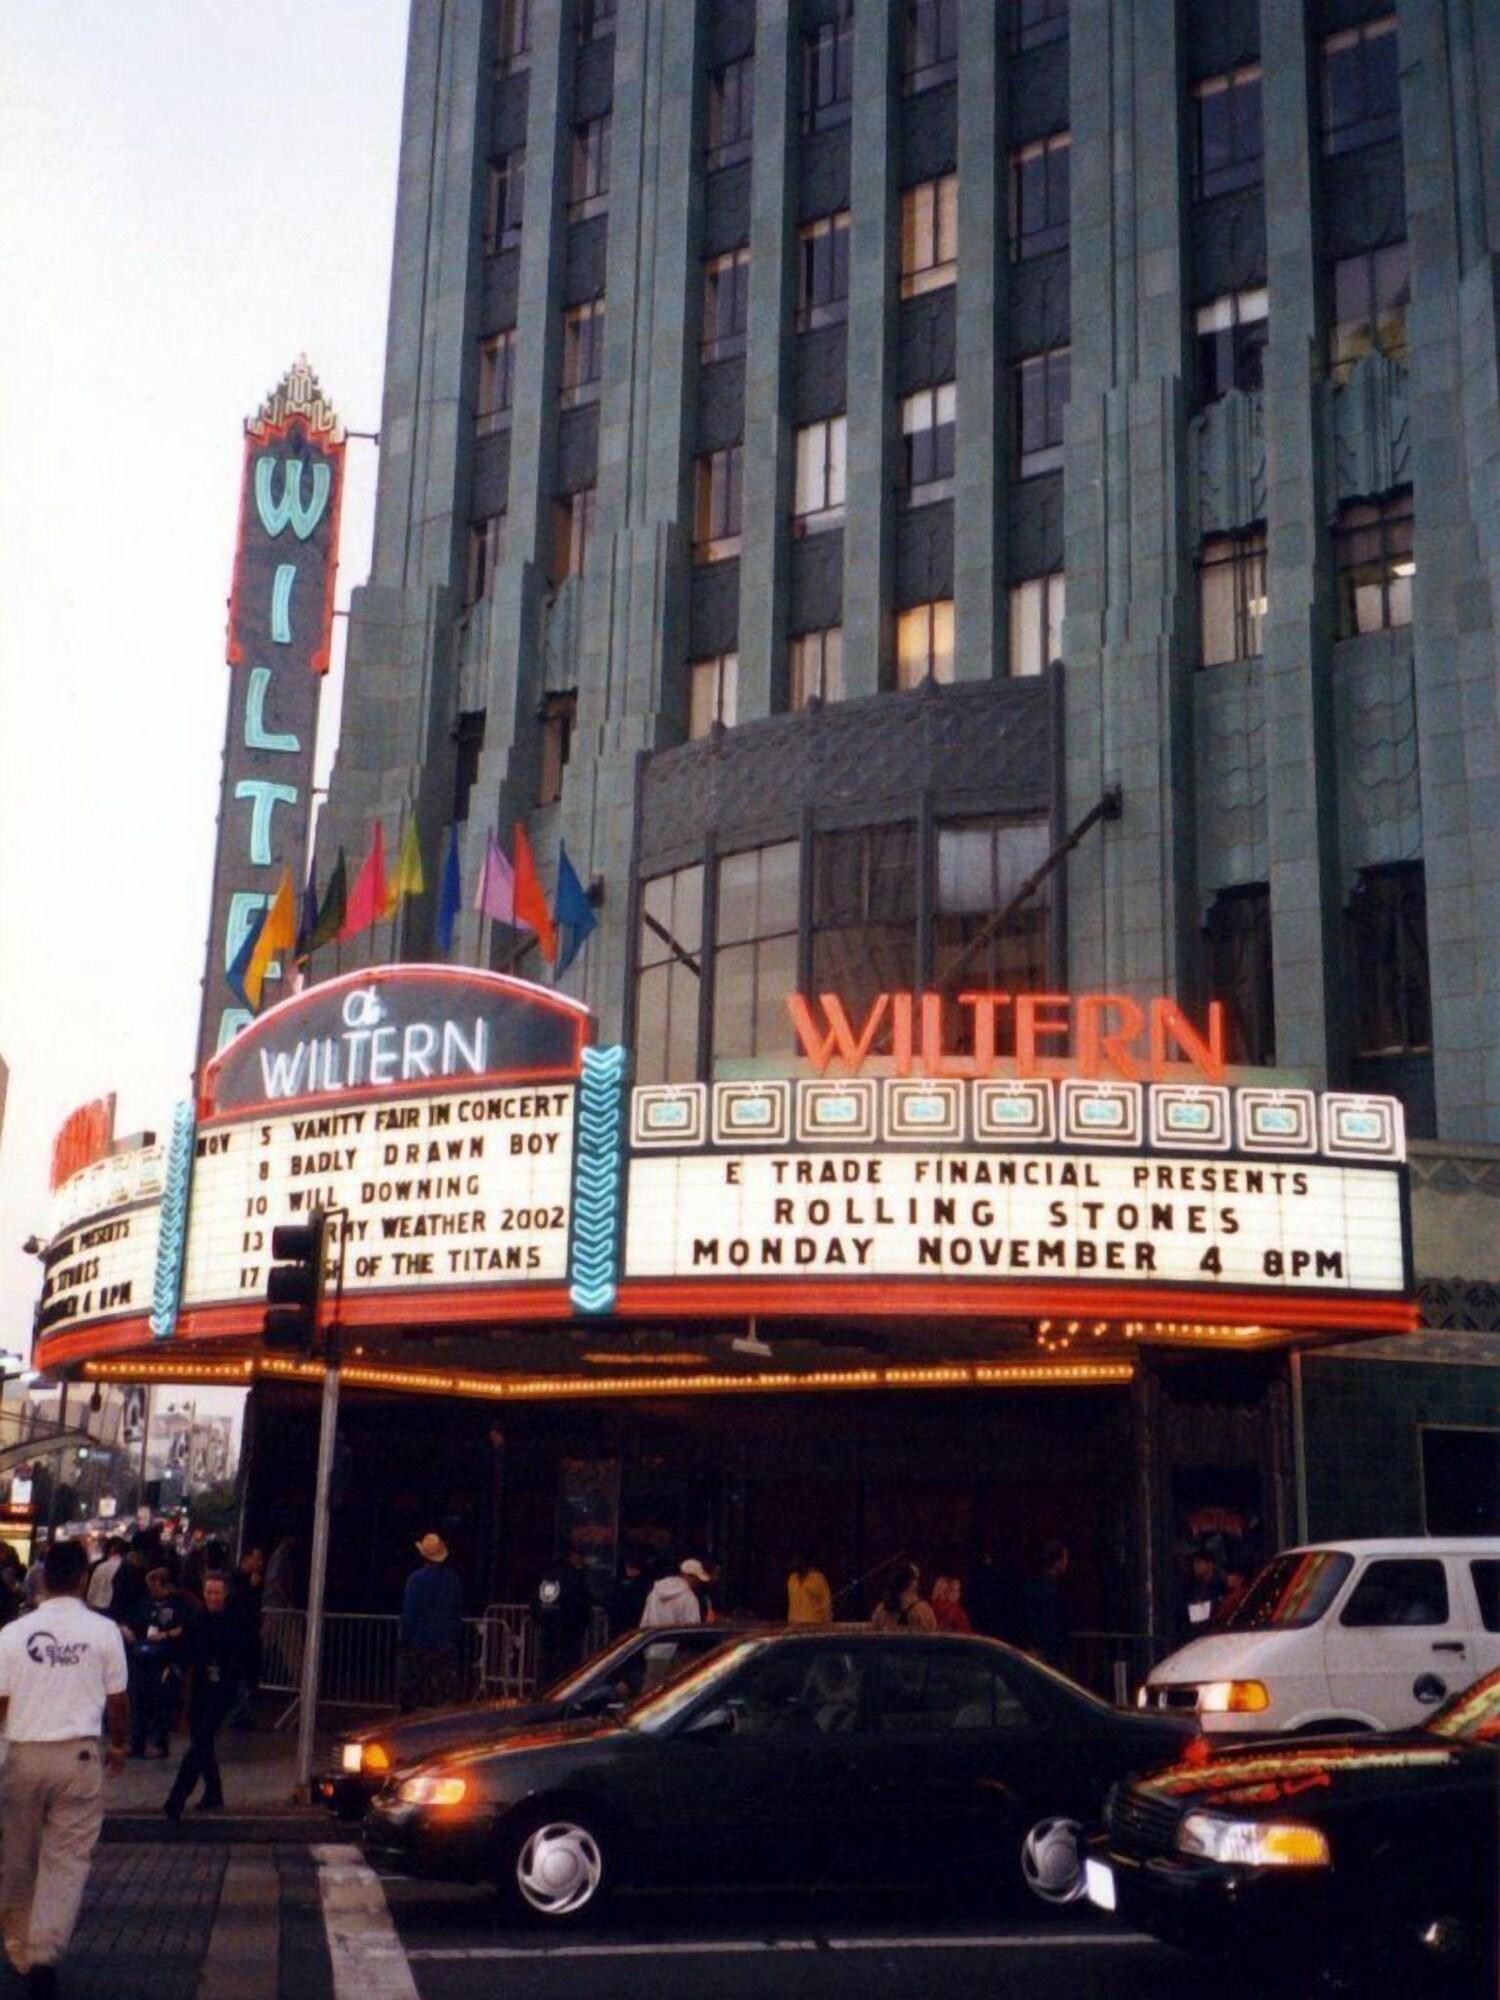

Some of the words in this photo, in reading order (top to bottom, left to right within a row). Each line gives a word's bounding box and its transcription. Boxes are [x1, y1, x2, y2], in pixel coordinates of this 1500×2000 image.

[261, 1016, 489, 1099] WILTERN
[786, 991, 1227, 1082] WILTERN
[196, 1133, 230, 1157] NOV
[261, 1126, 272, 1146] 5
[292, 1111, 366, 1141] VANITY
[374, 1106, 420, 1131] FAIR
[429, 1103, 450, 1127] IN
[458, 1093, 569, 1120] CONCERT
[259, 1161, 270, 1180] 8
[291, 1148, 357, 1176] BADLY
[384, 1136, 485, 1166] DRAWN
[510, 1132, 560, 1156] BOY
[726, 1162, 741, 1185] E
[771, 1160, 883, 1184] TRADE
[914, 1160, 1101, 1188] FINANCIAL
[1133, 1166, 1309, 1196] PRESENTS
[247, 1196, 268, 1218] 10
[289, 1186, 338, 1213] WILL
[361, 1174, 480, 1204] DOWNING
[775, 1198, 995, 1227] ROLLING
[1049, 1201, 1240, 1235] STONES
[243, 1231, 264, 1252] 13
[382, 1209, 487, 1240] WEATHER
[501, 1206, 565, 1231] 2002
[240, 1266, 260, 1288] 17
[356, 1256, 382, 1278] OF
[392, 1251, 434, 1275] THE
[448, 1245, 541, 1272] TITANS
[692, 1238, 874, 1266] MONDAY
[918, 1237, 1157, 1271] NOVEMBER
[1200, 1246, 1222, 1275] 4
[1263, 1249, 1343, 1278] 8PM
